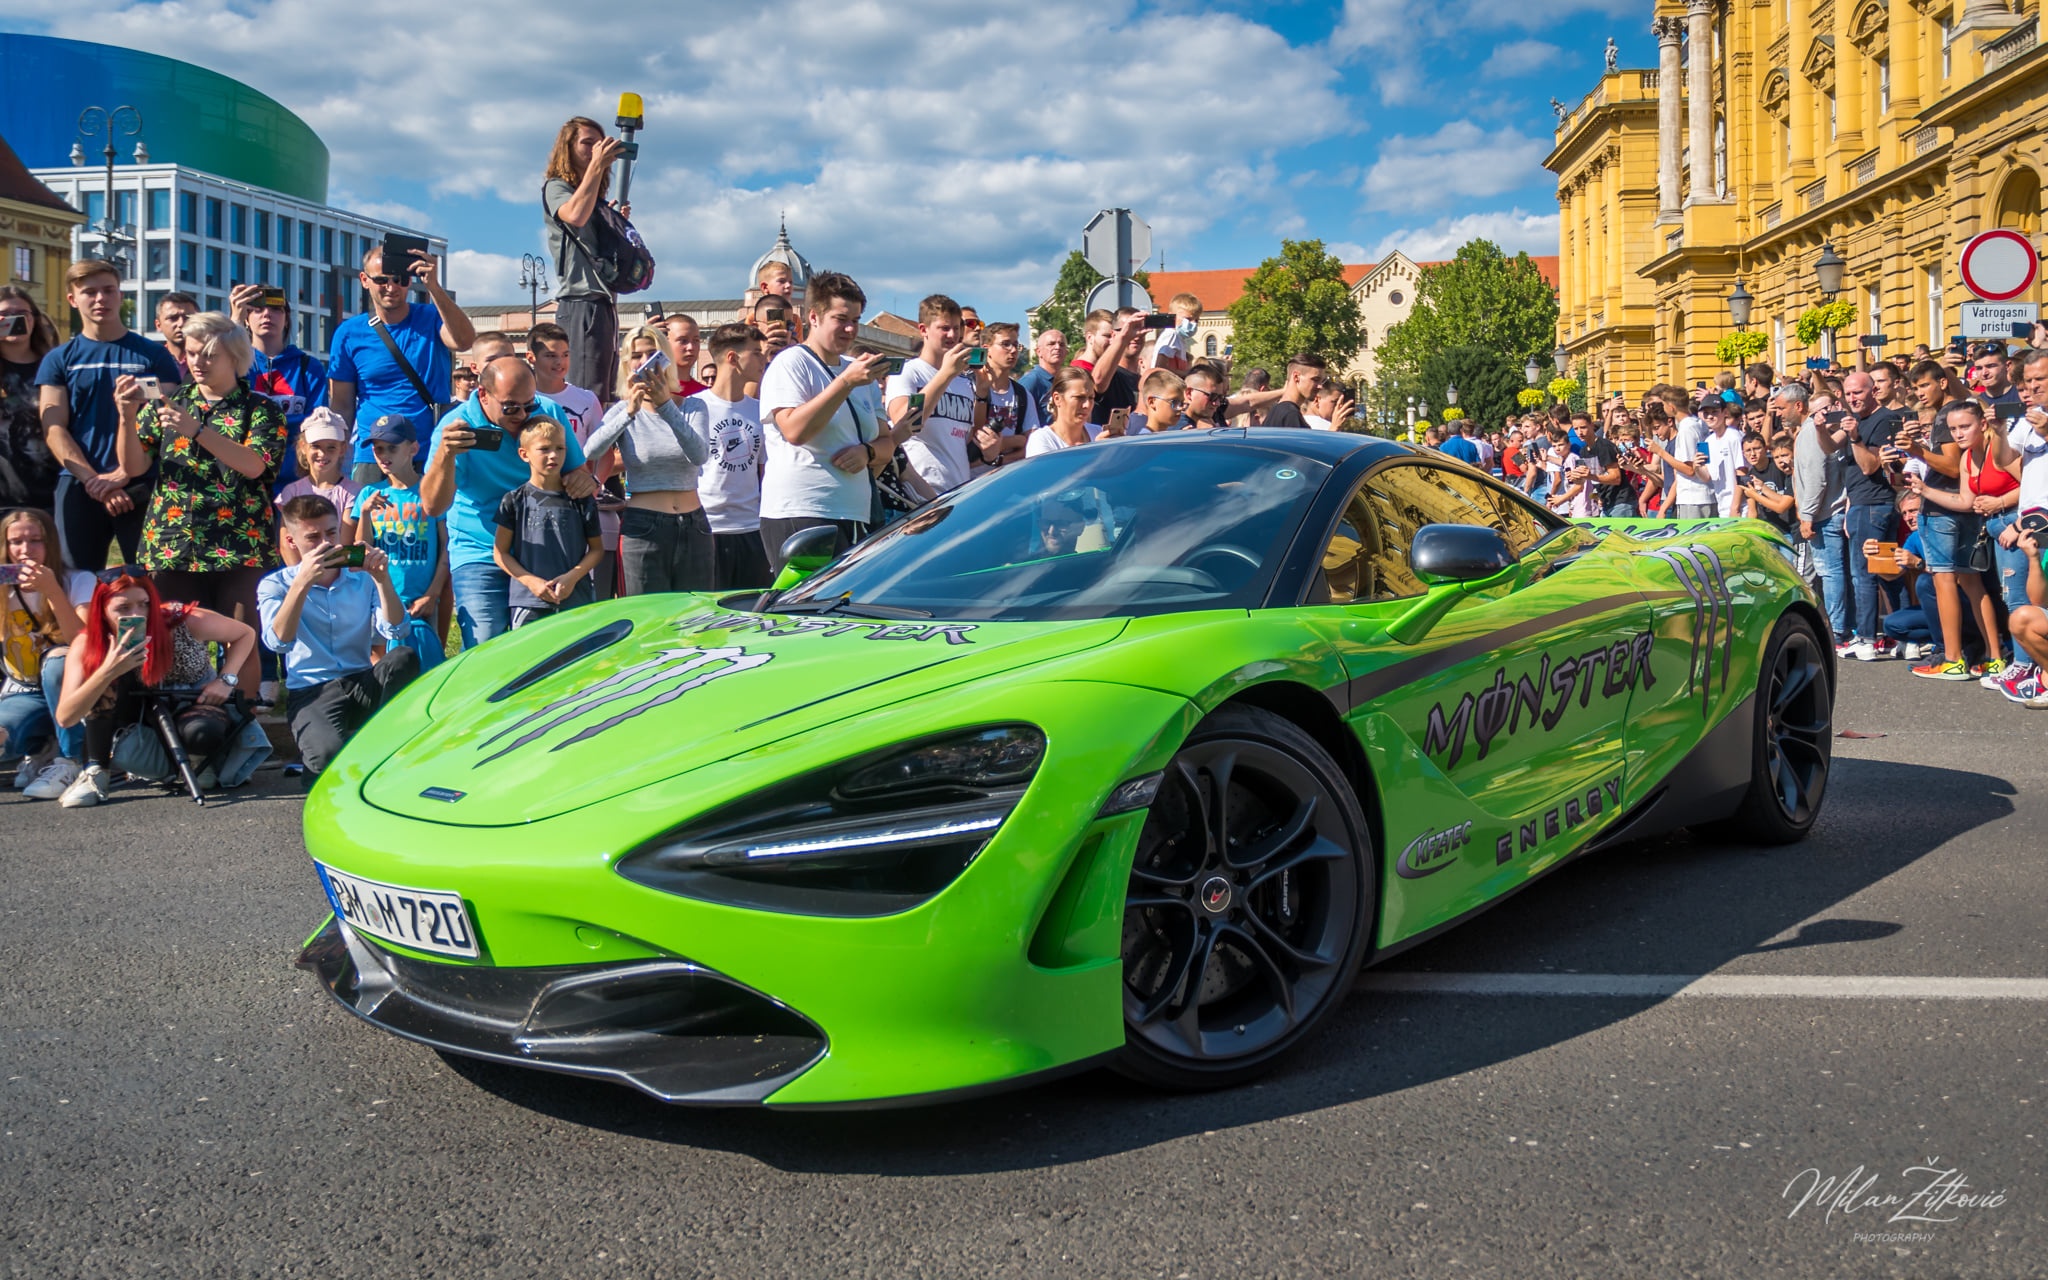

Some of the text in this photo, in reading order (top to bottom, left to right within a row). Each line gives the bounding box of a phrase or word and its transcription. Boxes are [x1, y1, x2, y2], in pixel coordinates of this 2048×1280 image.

[1972, 307, 2027, 320] Vatrogasni
[1981, 321, 2011, 334] pristu
[713, 418, 729, 433] JUST
[732, 418, 743, 427] DO
[1496, 776, 1622, 866] ENERGY
